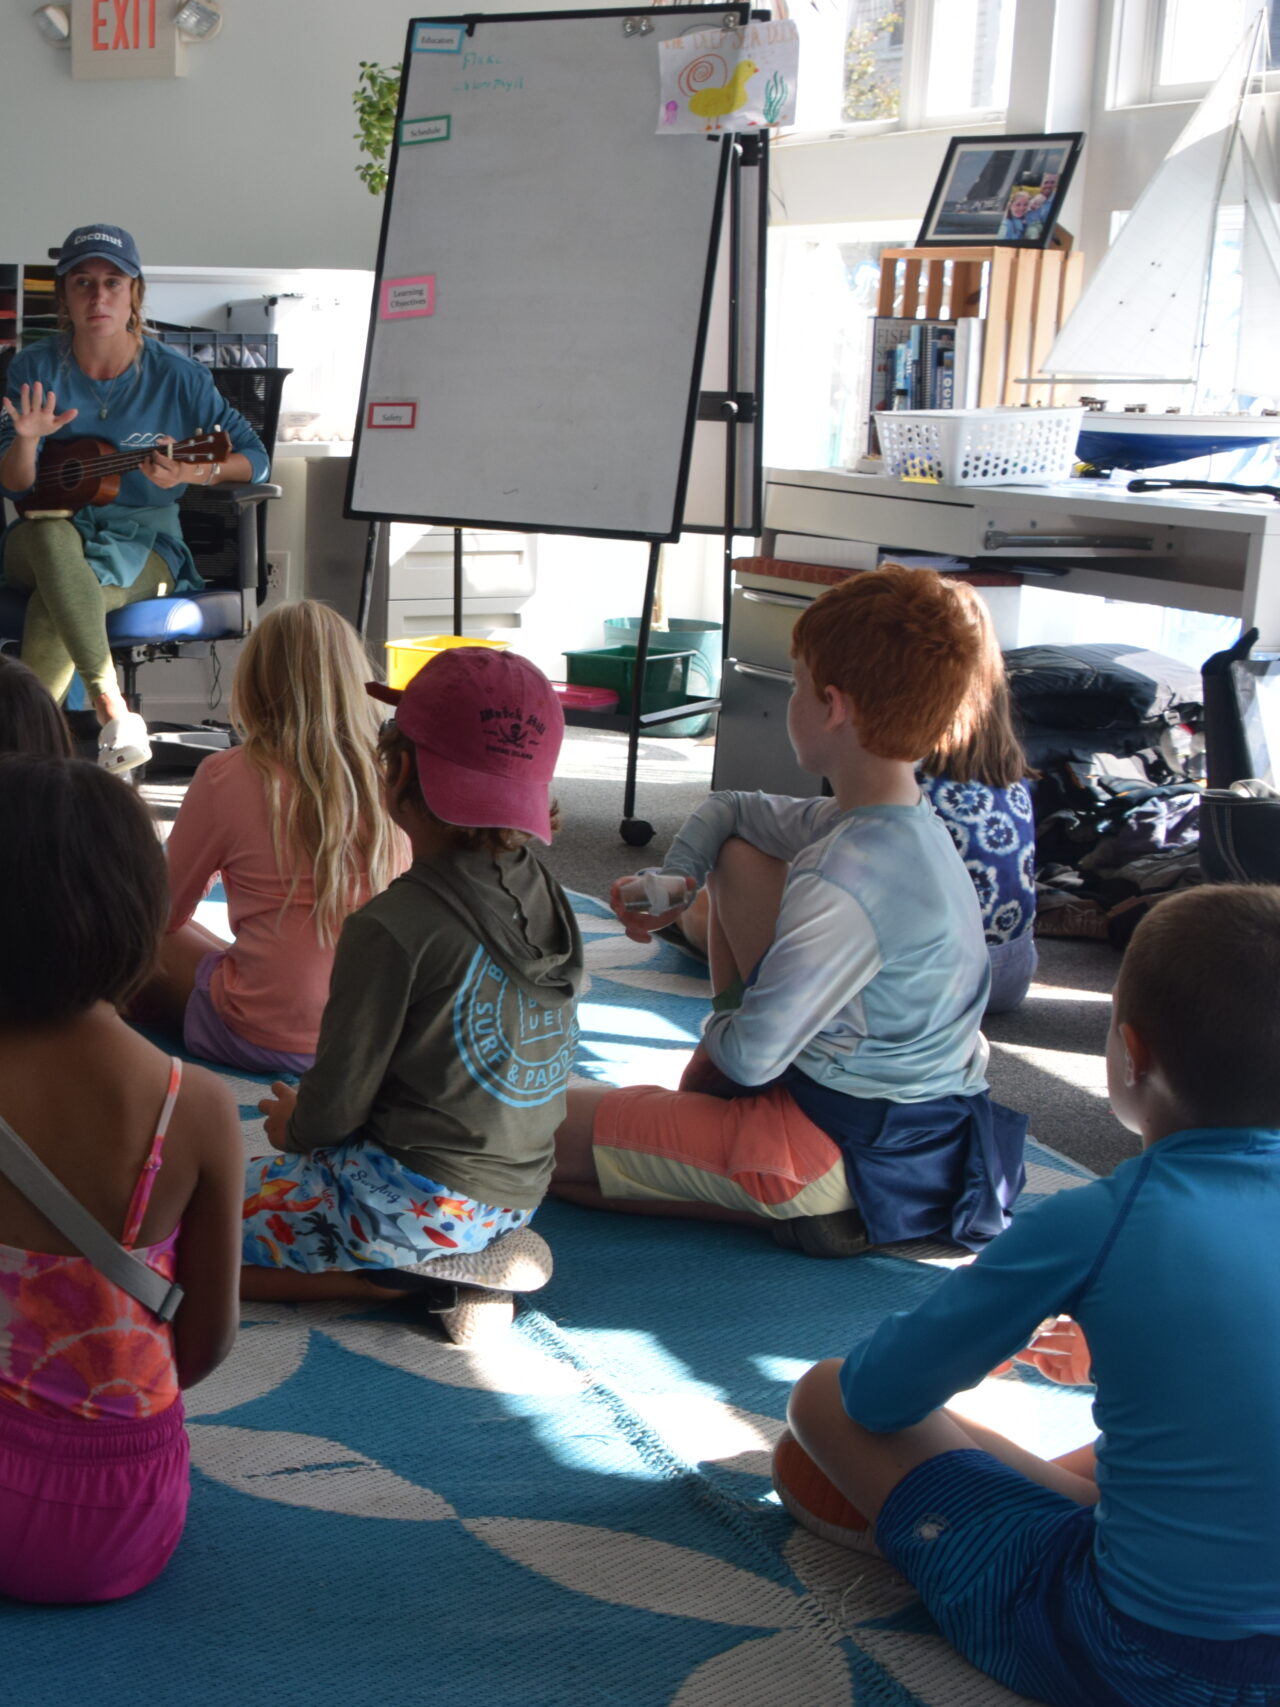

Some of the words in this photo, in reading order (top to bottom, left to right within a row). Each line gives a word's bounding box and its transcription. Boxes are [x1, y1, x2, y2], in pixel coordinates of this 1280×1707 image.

[421, 35, 454, 44] Educators
[410, 125, 441, 137] Schedule
[74, 233, 123, 248] Coconut
[393, 289, 424, 297] Learning
[390, 299, 426, 309] Objectives
[382, 413, 402, 424] Safety
[480, 706, 523, 723] Watch
[526, 714, 546, 736] Hill
[474, 1002, 509, 1064] SURF
[507, 1064, 520, 1084] &
[350, 1169, 401, 1204] Surfing
